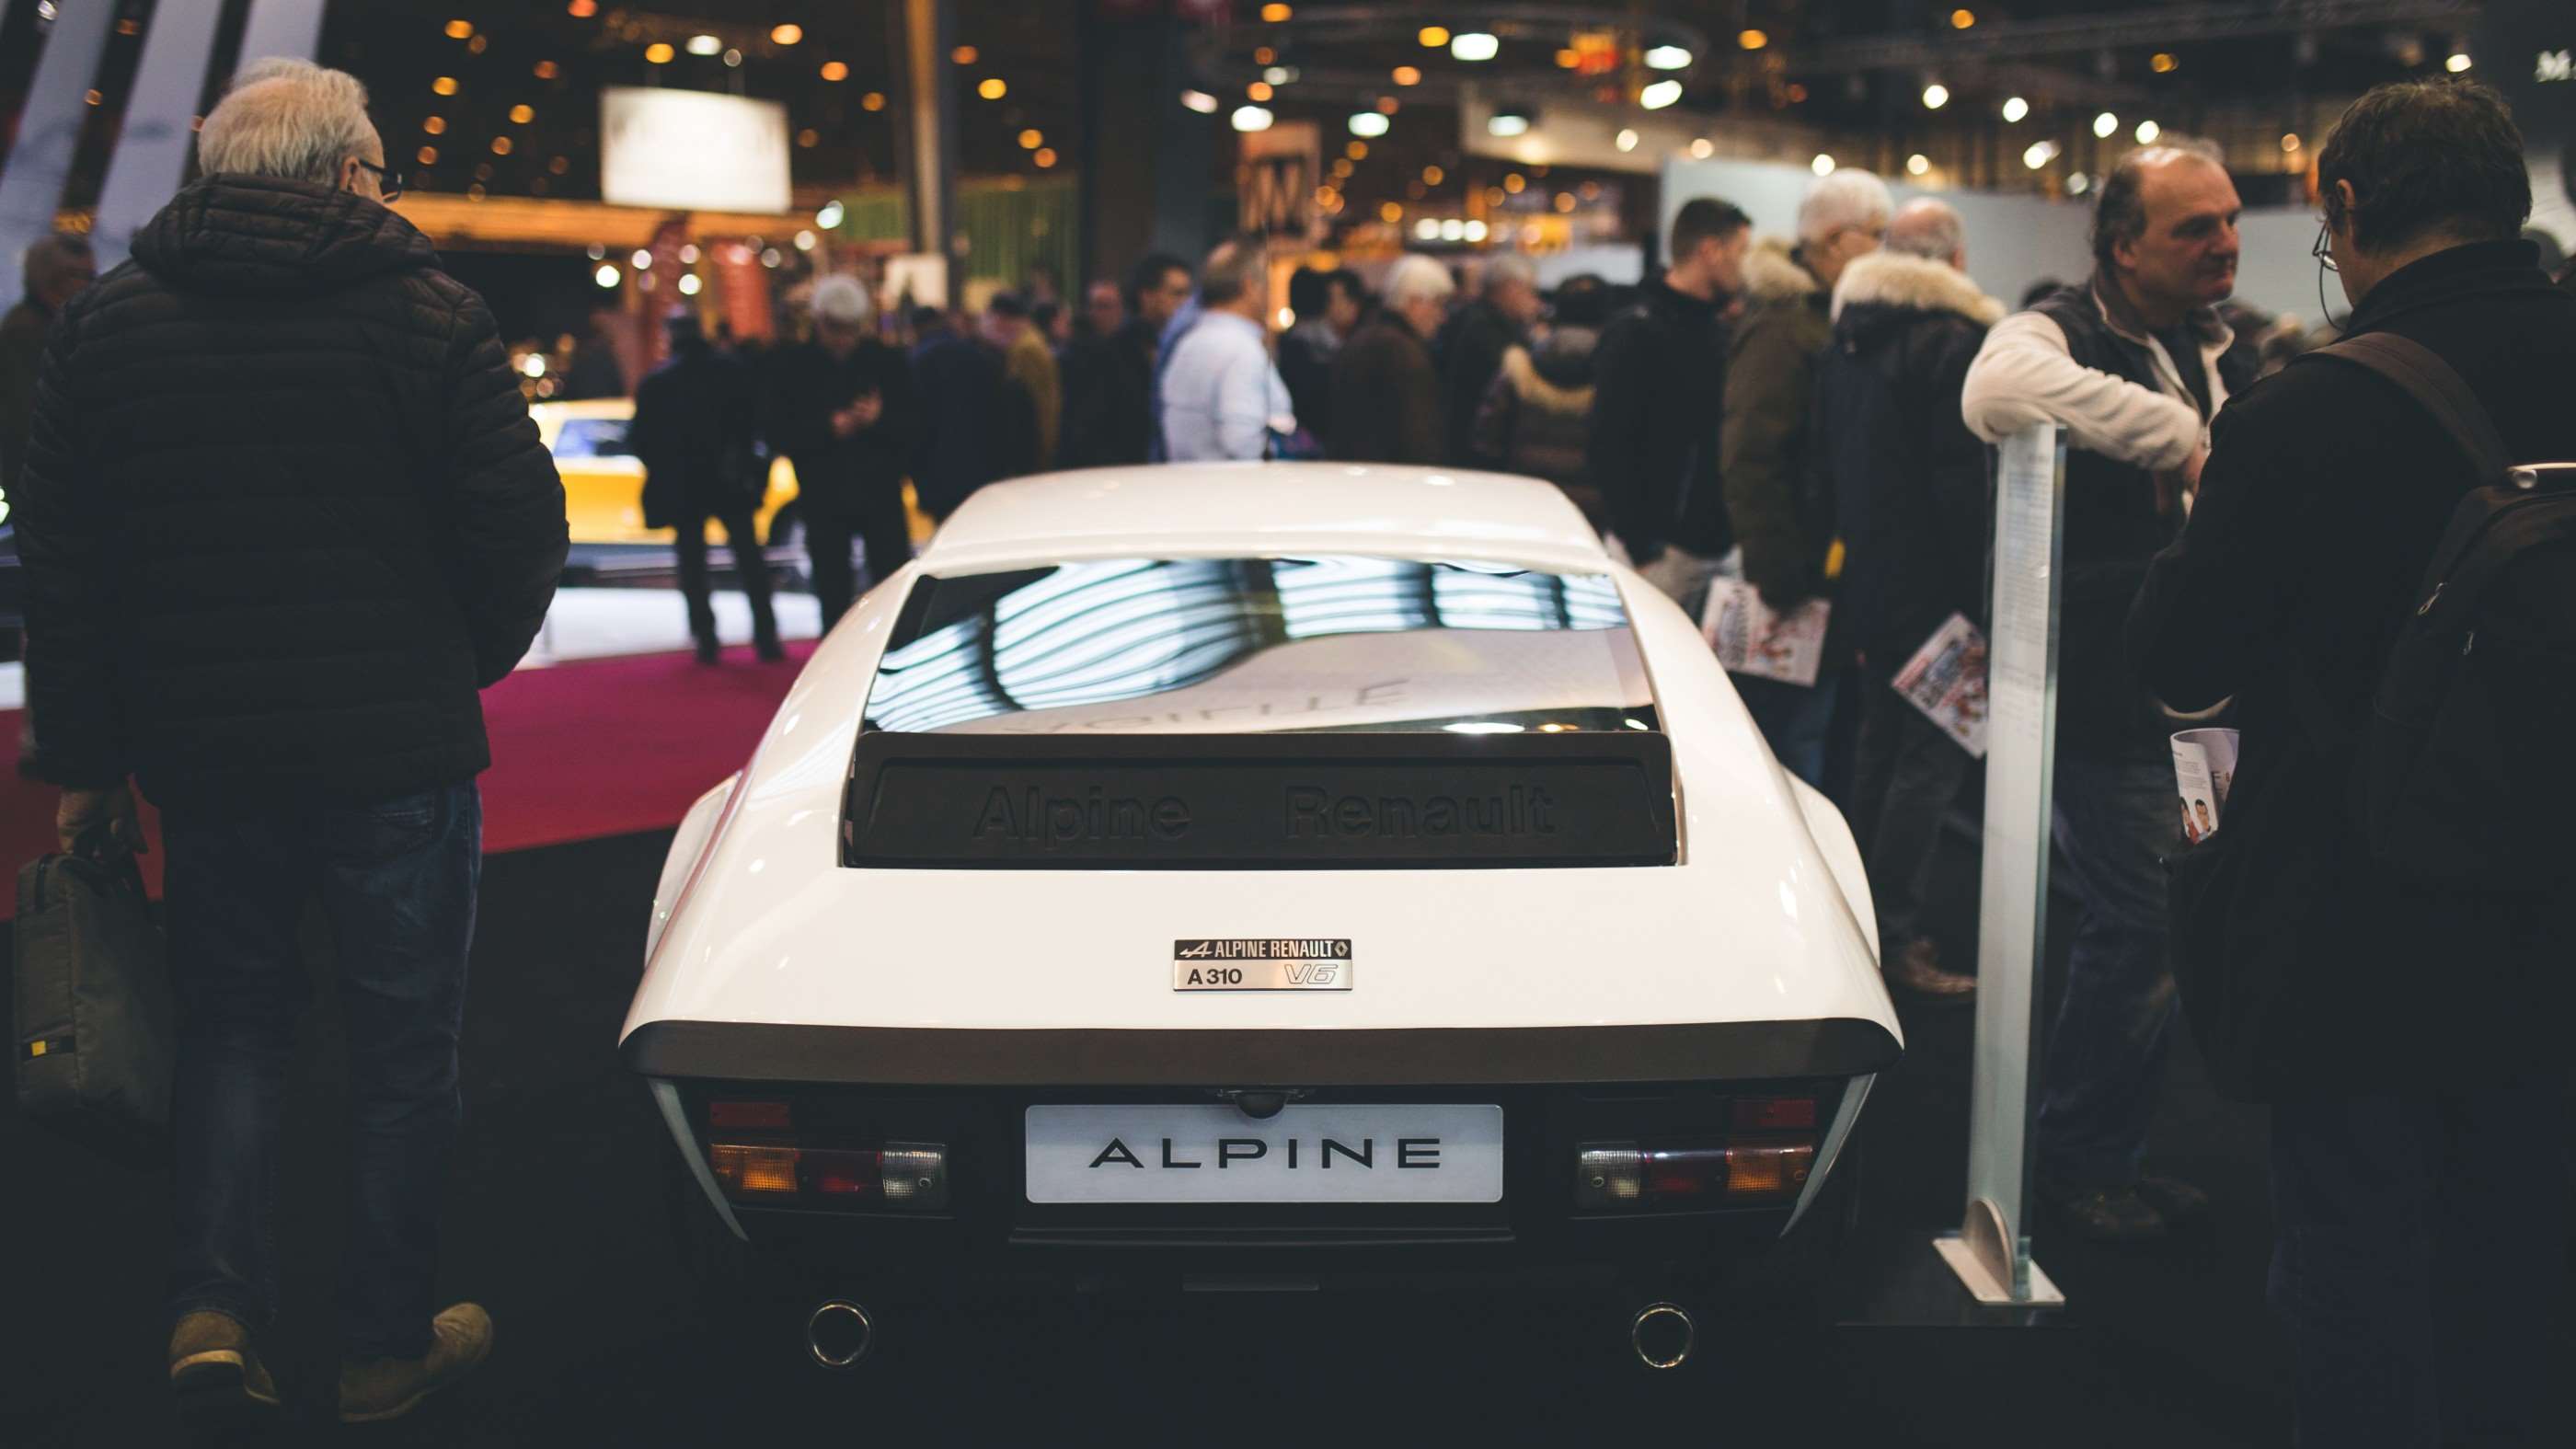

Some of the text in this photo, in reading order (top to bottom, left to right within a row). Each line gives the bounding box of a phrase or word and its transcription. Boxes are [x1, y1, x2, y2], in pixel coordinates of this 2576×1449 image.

[972, 784, 1557, 851] Alpine Renault
[1214, 940, 1334, 958] ALPINE RENAULT
[1284, 963, 1339, 985] V6
[1088, 1137, 1442, 1169] ALPINE
